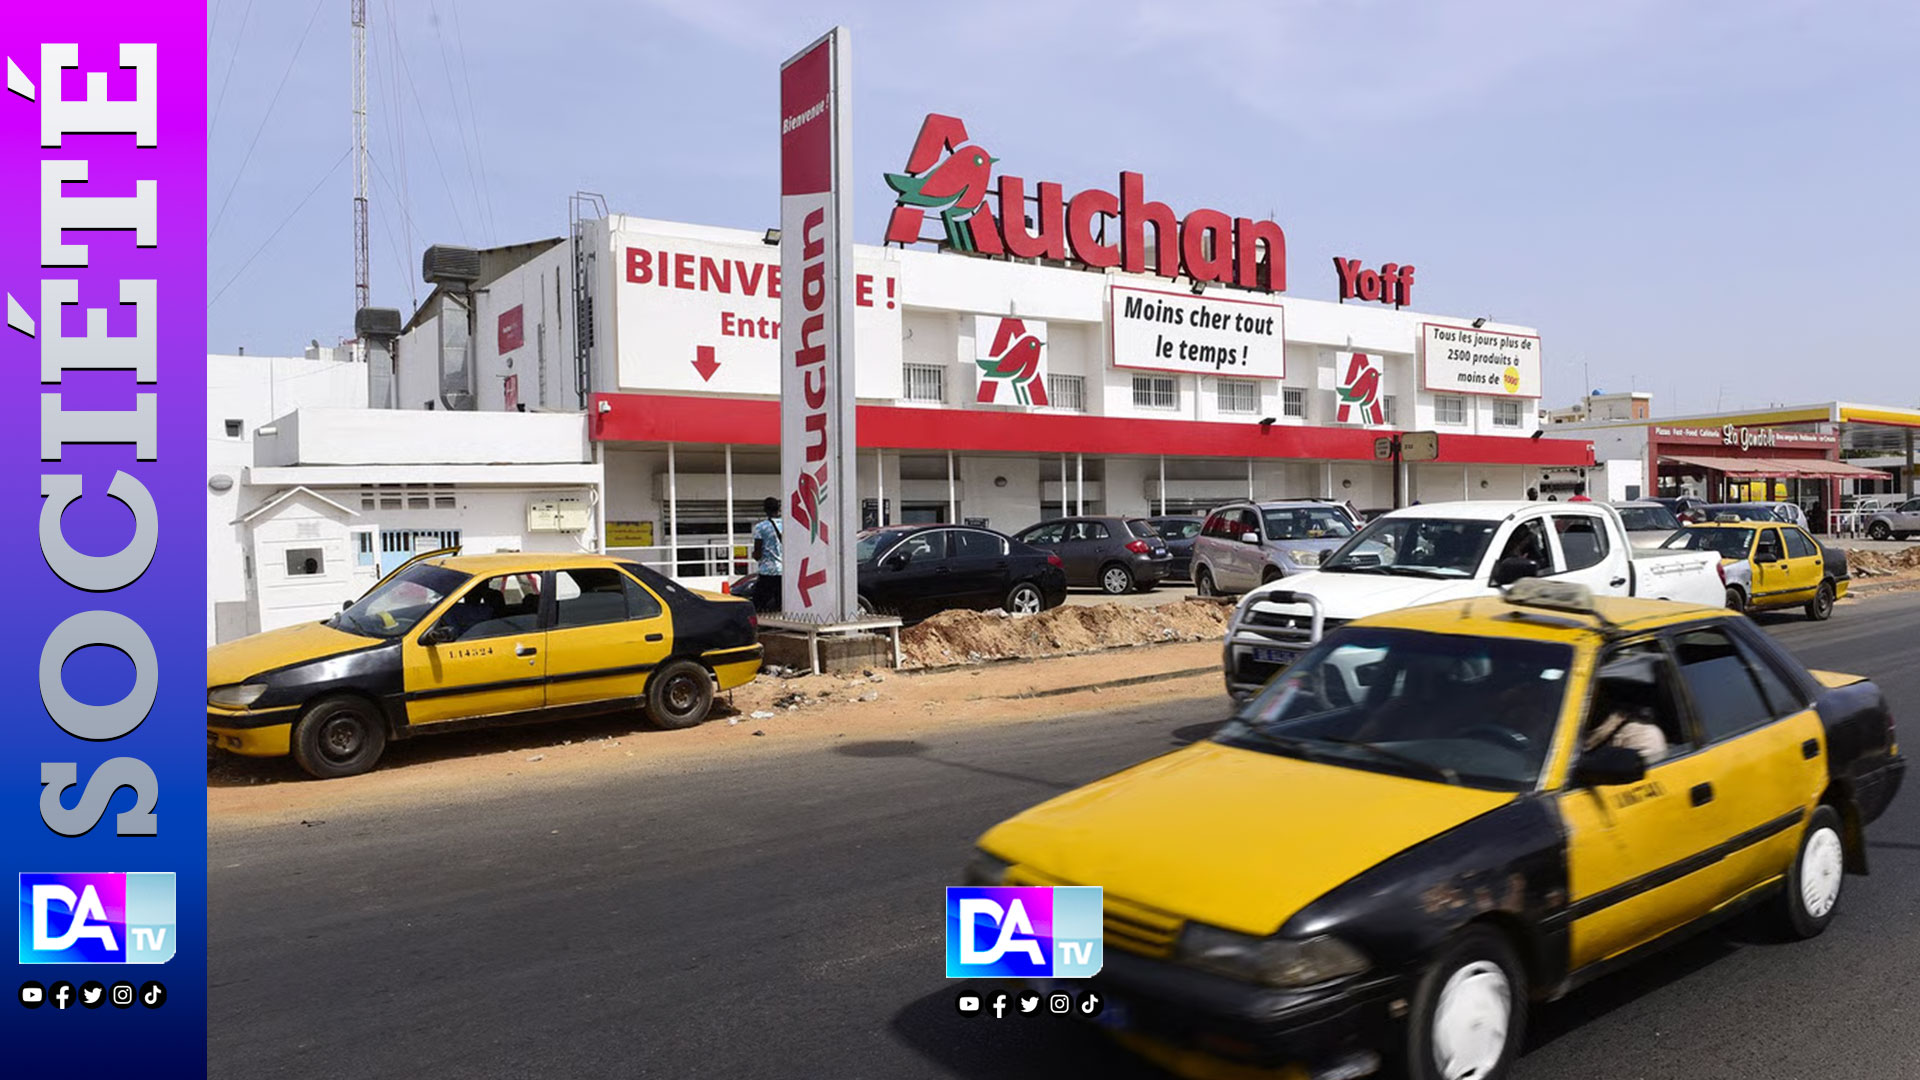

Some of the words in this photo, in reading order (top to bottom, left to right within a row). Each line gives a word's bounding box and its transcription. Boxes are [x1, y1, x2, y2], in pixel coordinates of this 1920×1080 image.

[884, 113, 1287, 292] Auchan
[625, 247, 874, 308] BIENVEE
[1334, 257, 1415, 306] Yoff
[1124, 296, 1184, 325] Moins
[1189, 305, 1231, 330] cher
[1235, 312, 1274, 336] tout
[1155, 334, 1173, 358] le
[1179, 340, 1237, 370] temps
[1241, 345, 1248, 366] !
[1433, 328, 1456, 342] Tous
[1458, 331, 1472, 344] les
[1473, 333, 1498, 348] jours
[1499, 336, 1519, 350] plus
[1521, 339, 1532, 350] de
[1447, 349, 1471, 362] 2500
[1472, 352, 1512, 366] produits
[790, 206, 831, 546] Auchan
[1457, 371, 1486, 384] moins
[1488, 373, 1500, 385] de
